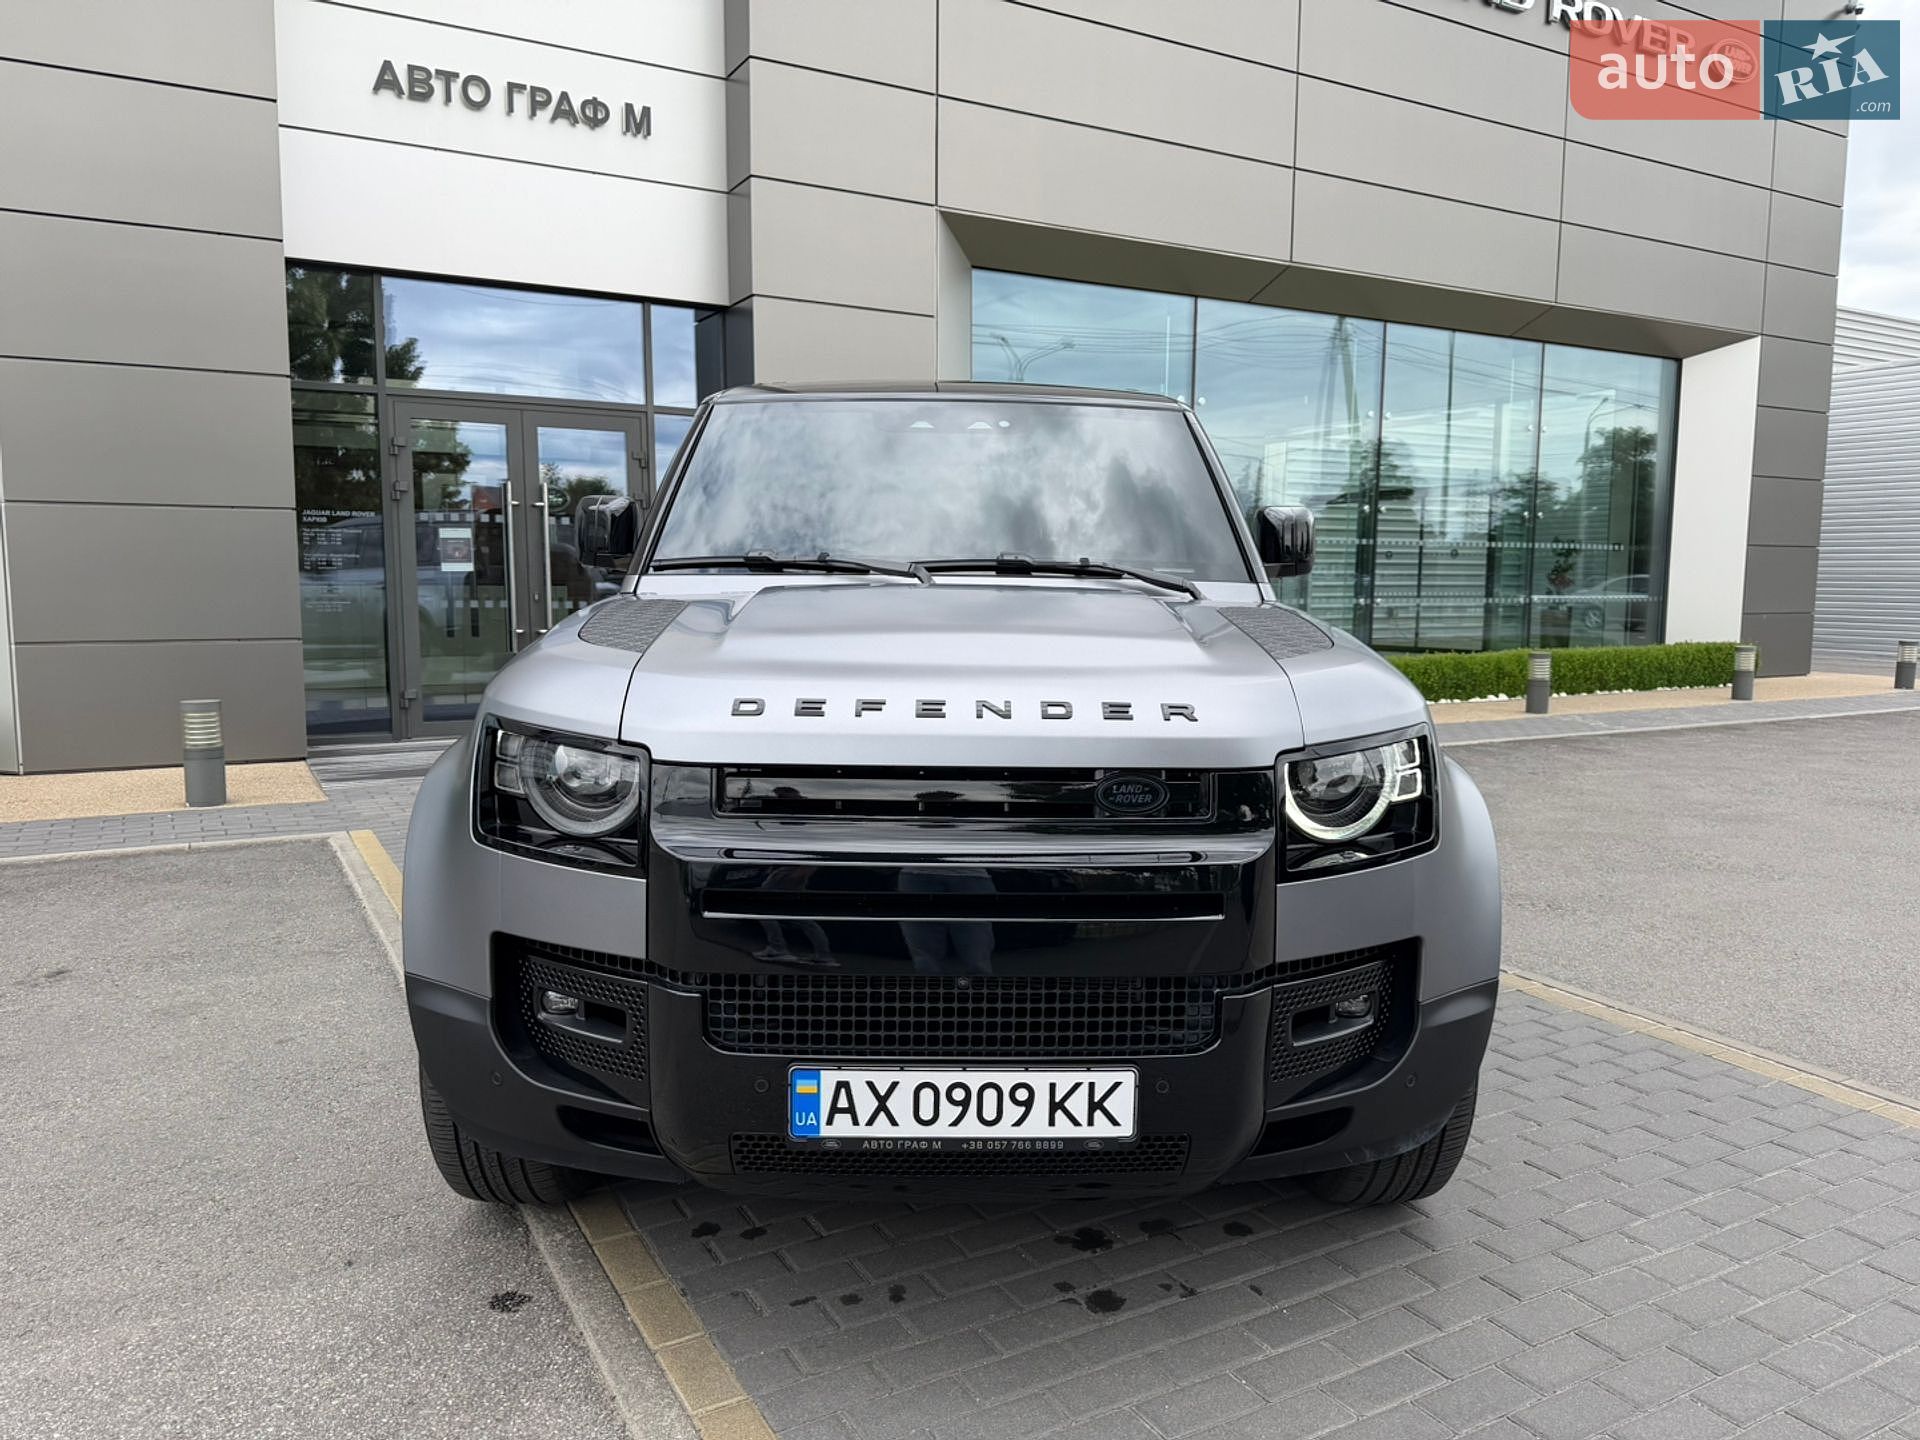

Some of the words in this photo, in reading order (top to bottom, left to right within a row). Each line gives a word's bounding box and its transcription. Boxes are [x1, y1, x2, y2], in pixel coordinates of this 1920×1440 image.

[371, 59, 492, 111] АВТО
[505, 80, 611, 130] ГРАФ
[622, 101, 652, 139] М
[351, 510, 376, 518] ROVER
[730, 697, 1200, 723] DEFENDER
[825, 1080, 900, 1127] AX
[912, 1081, 1036, 1127] 0909
[1048, 1081, 1124, 1127] KK
[795, 1111, 818, 1127] UA
[862, 1140, 894, 1150] АВТО
[897, 1140, 929, 1150] ГРАФ
[932, 1140, 942, 1150] М
[961, 1140, 983, 1150] +38
[986, 1140, 1008, 1150] 057
[1011, 1140, 1032, 1150] 766
